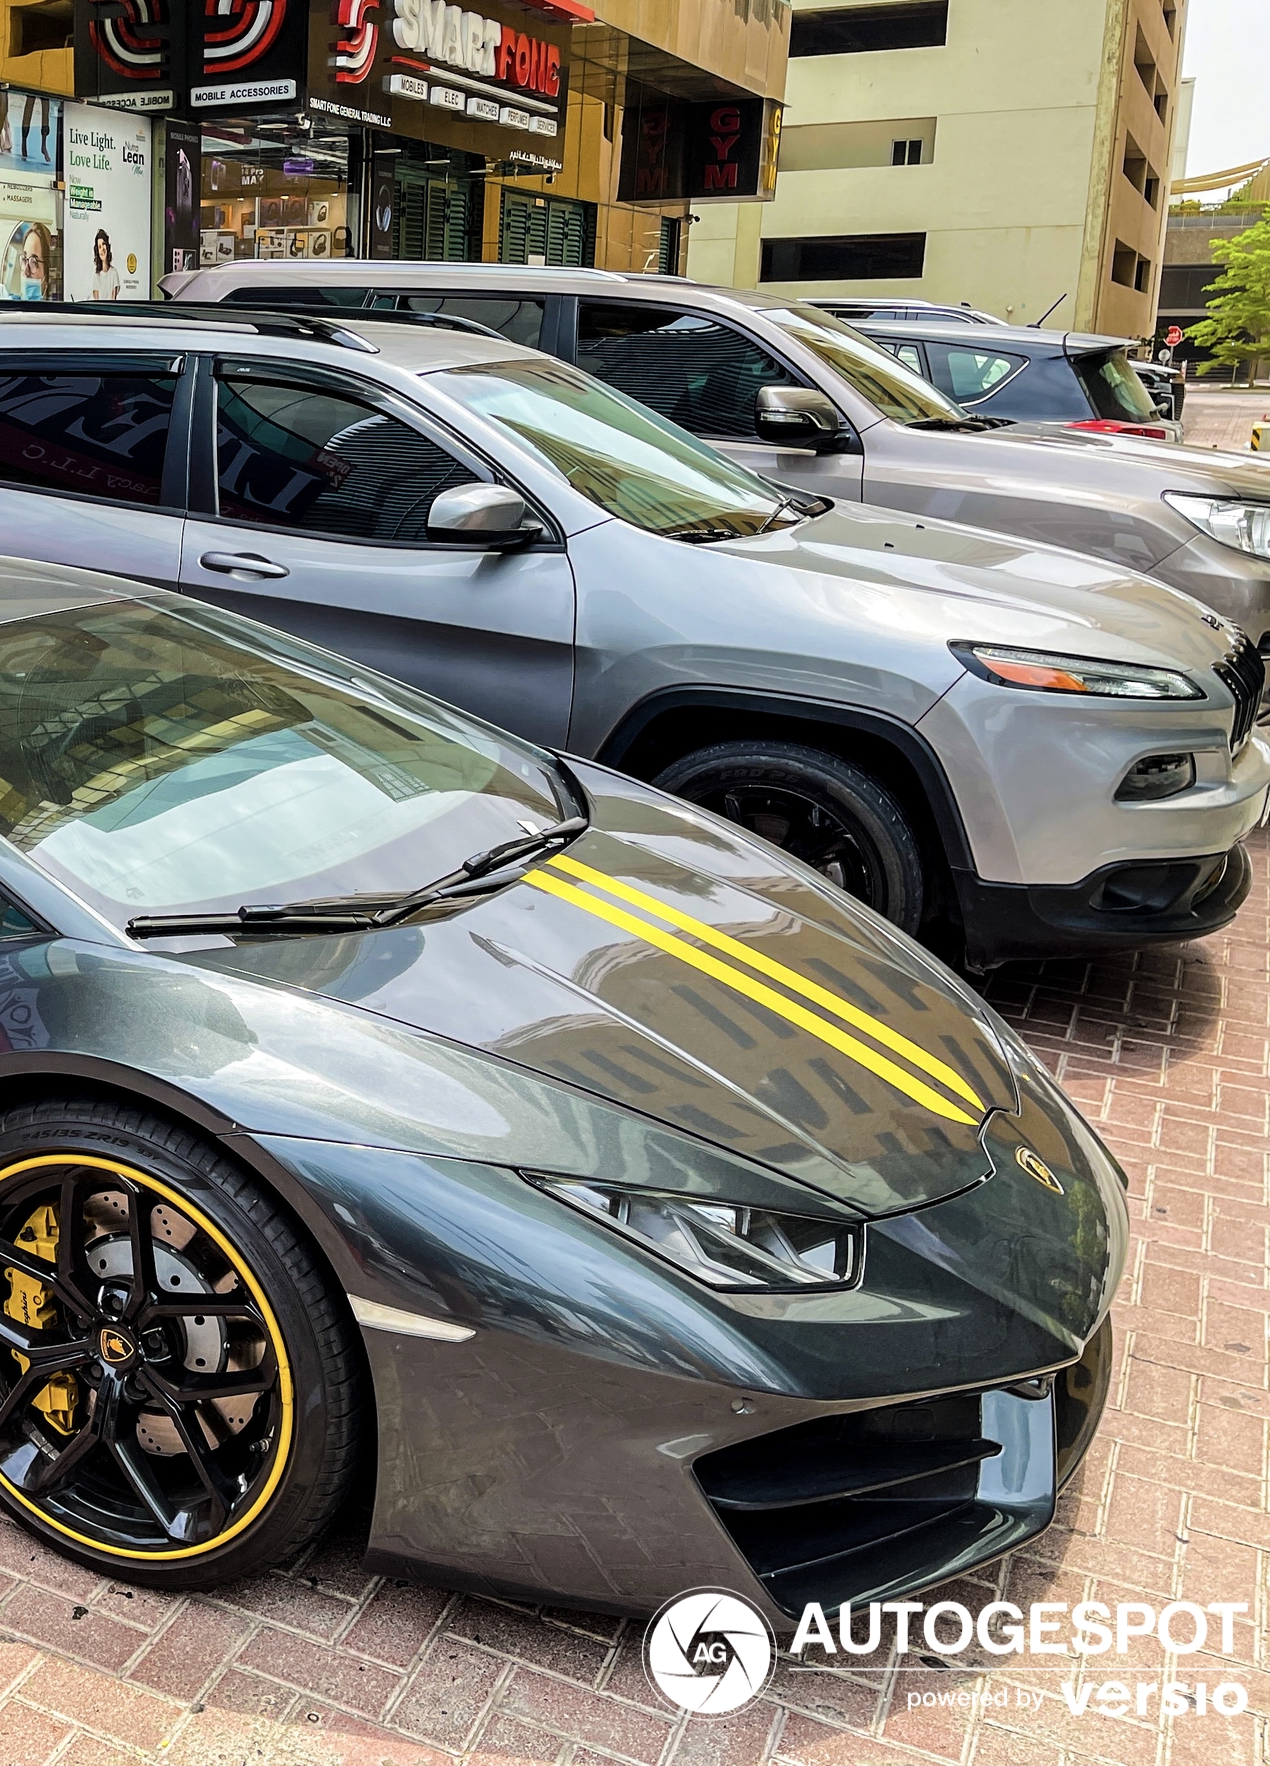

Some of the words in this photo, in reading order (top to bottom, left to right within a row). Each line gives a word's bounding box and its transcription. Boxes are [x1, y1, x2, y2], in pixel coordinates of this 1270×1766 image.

[195, 90, 226, 103] MOBILE
[230, 85, 290, 99] ACCESSORIES
[401, 78, 425, 96] MOBILES
[444, 91, 459, 106] ELEC
[309, 97, 327, 111] SMART
[326, 101, 340, 115] FONE
[339, 105, 362, 121] GENERAL
[361, 110, 381, 125] TRADING
[476, 102, 498, 117] WATCHES
[508, 110, 528, 126] PERFUMES
[536, 119, 557, 134] SERVICES
[69, 128, 89, 146] Live
[91, 131, 117, 152] Light.
[170, 131, 184, 141] MOBILE
[185, 134, 199, 144] PHONES
[122, 146, 145, 166] Lean
[703, 107, 741, 189] GYM
[762, 108, 781, 191] GYM
[69, 150, 91, 168] Love
[93, 153, 112, 171] Life.
[69, 174, 82, 185] Now
[6, 194, 33, 204] MASSAGERS
[70, 187, 89, 199] Weight
[69, 211, 90, 222] Naturally
